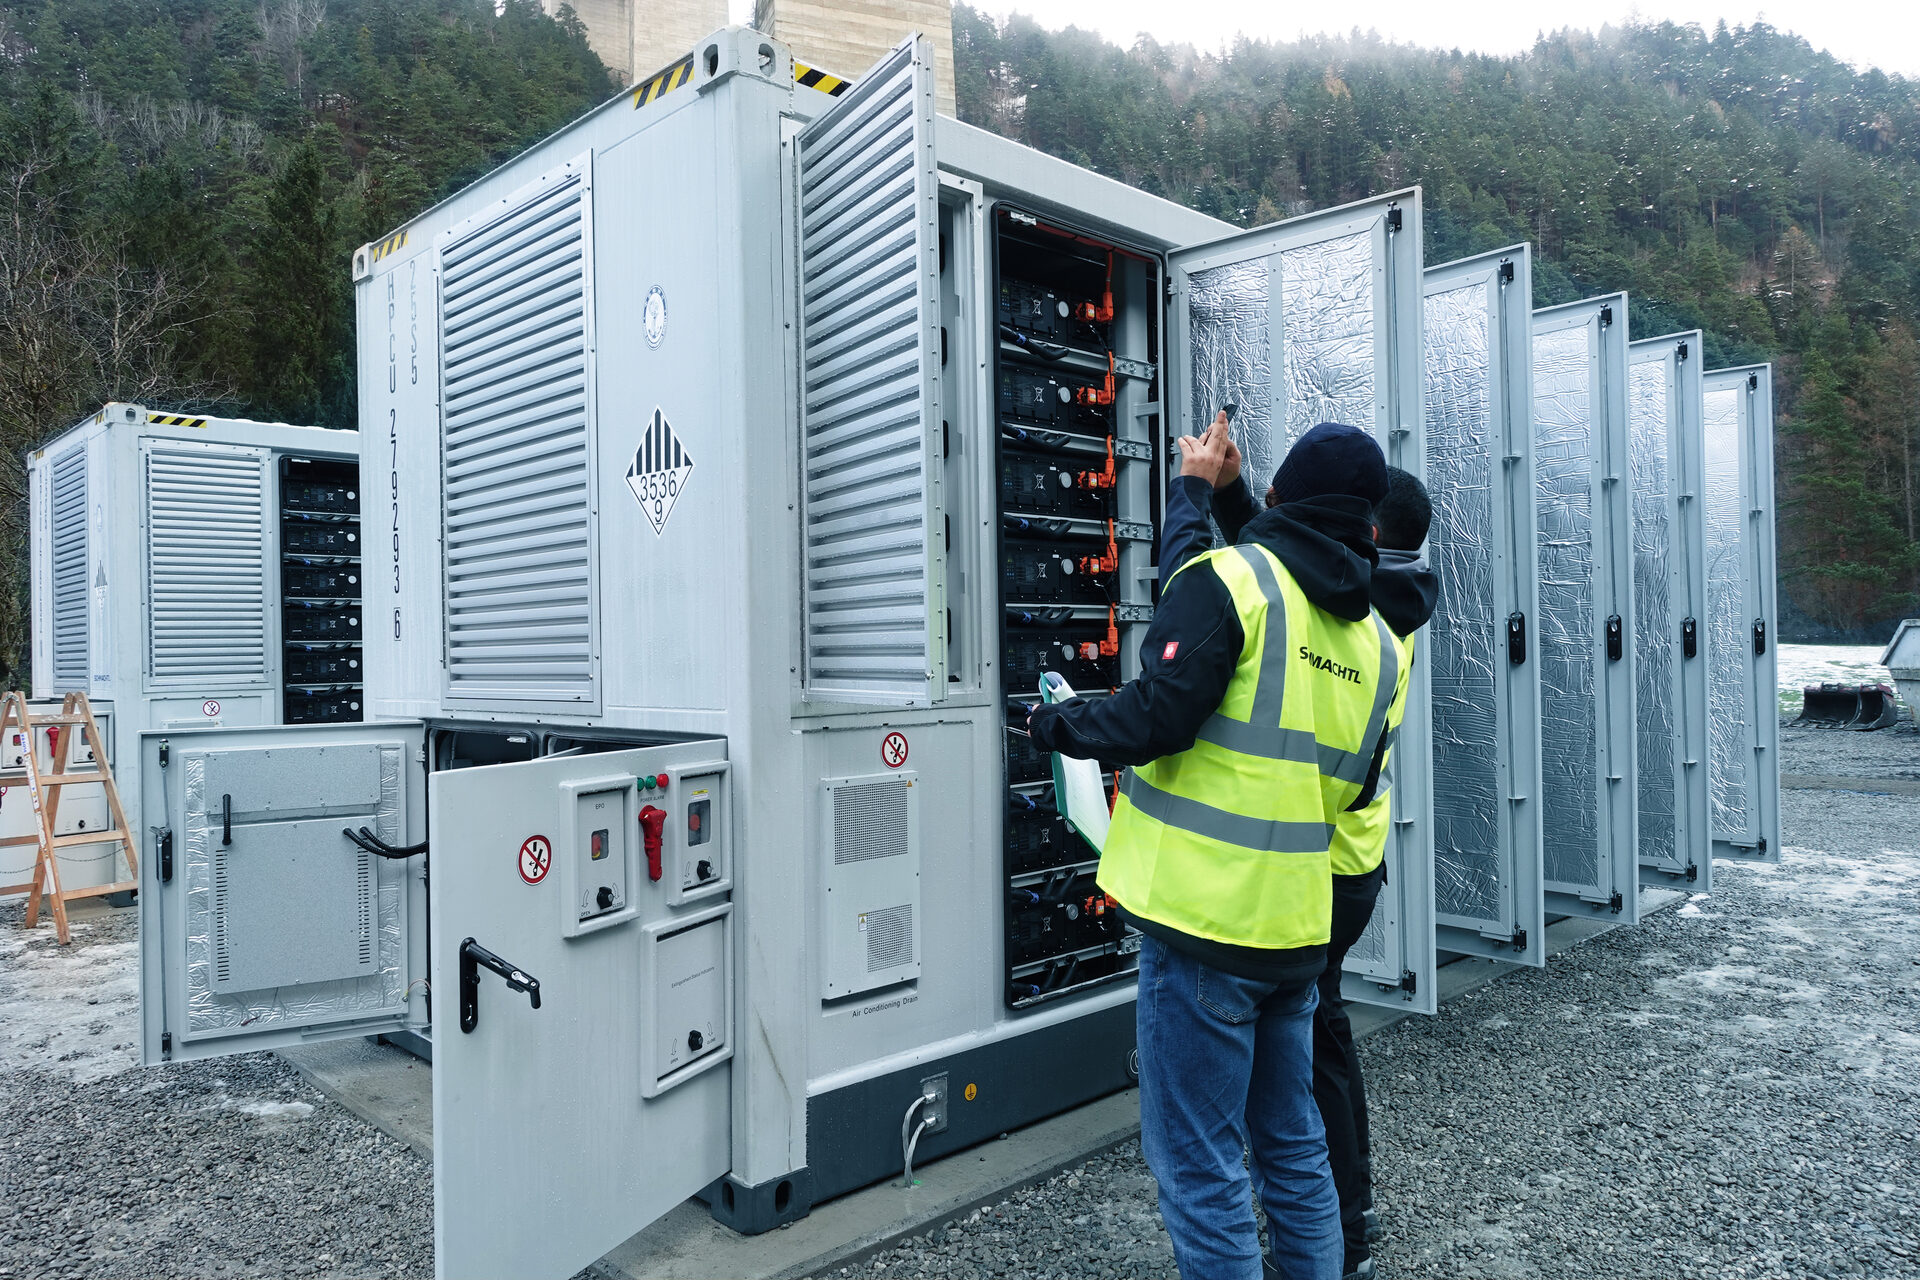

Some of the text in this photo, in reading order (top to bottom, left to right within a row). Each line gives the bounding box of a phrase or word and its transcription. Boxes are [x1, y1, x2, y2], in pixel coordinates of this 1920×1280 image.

[388, 271, 401, 639] HPCU 279293 6
[640, 470, 677, 502] 3536
[655, 499, 663, 523] 9
[595, 802, 605, 810] EPO
[852, 996, 919, 1018] Air Conditioning Drain
